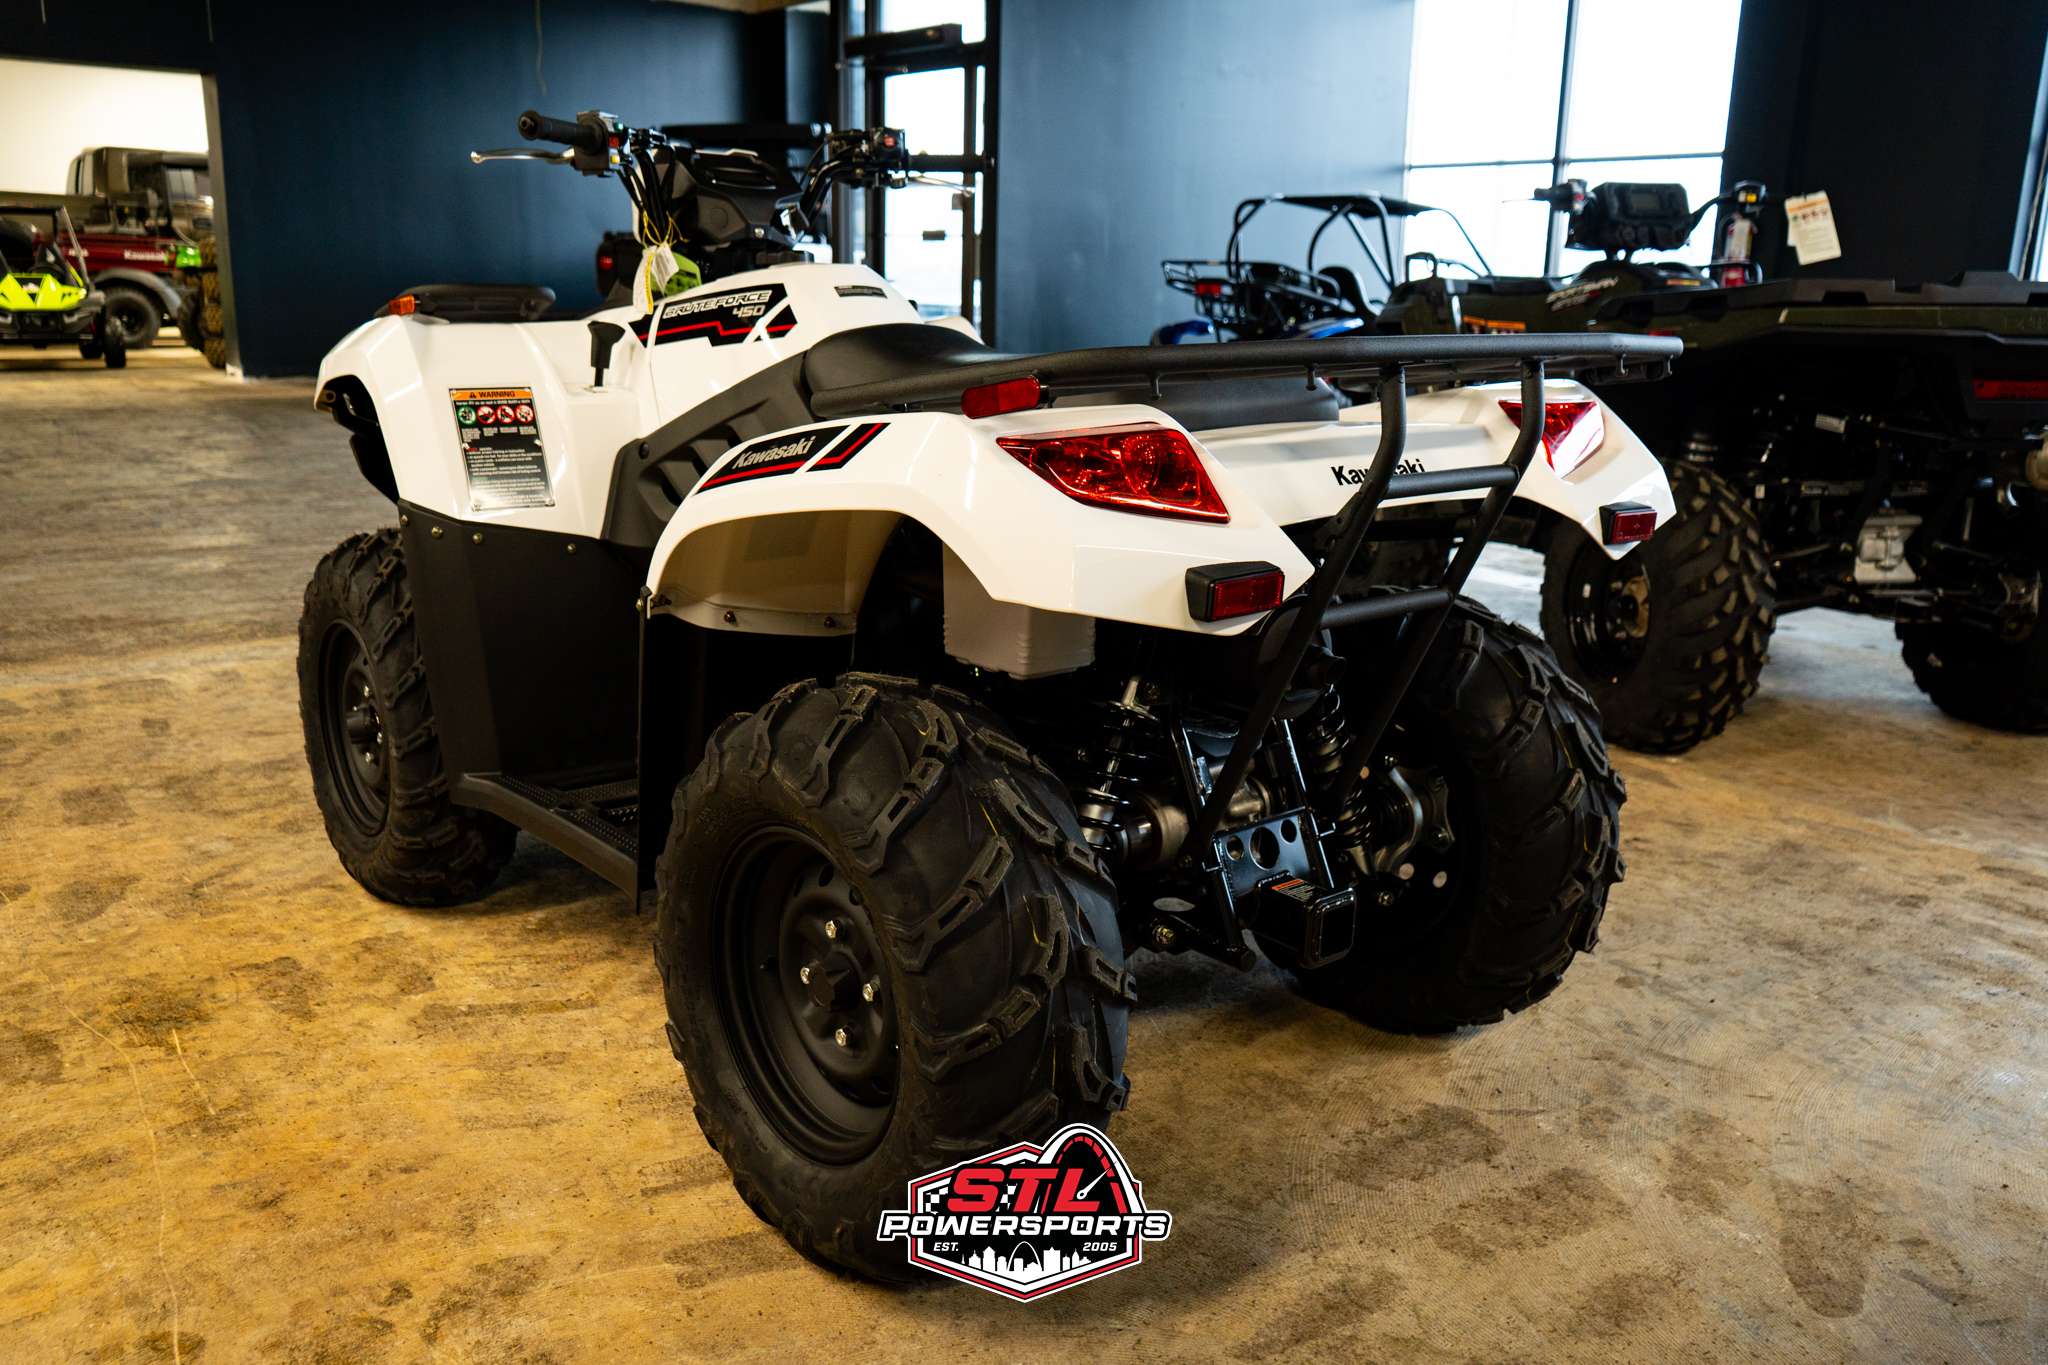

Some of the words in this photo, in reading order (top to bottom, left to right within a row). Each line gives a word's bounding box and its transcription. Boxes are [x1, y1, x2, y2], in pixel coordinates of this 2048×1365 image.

[732, 304, 766, 318] 450
[478, 390, 516, 398] WARNING
[732, 435, 817, 470] Kawasaki
[1331, 458, 1426, 486] Kawaki
